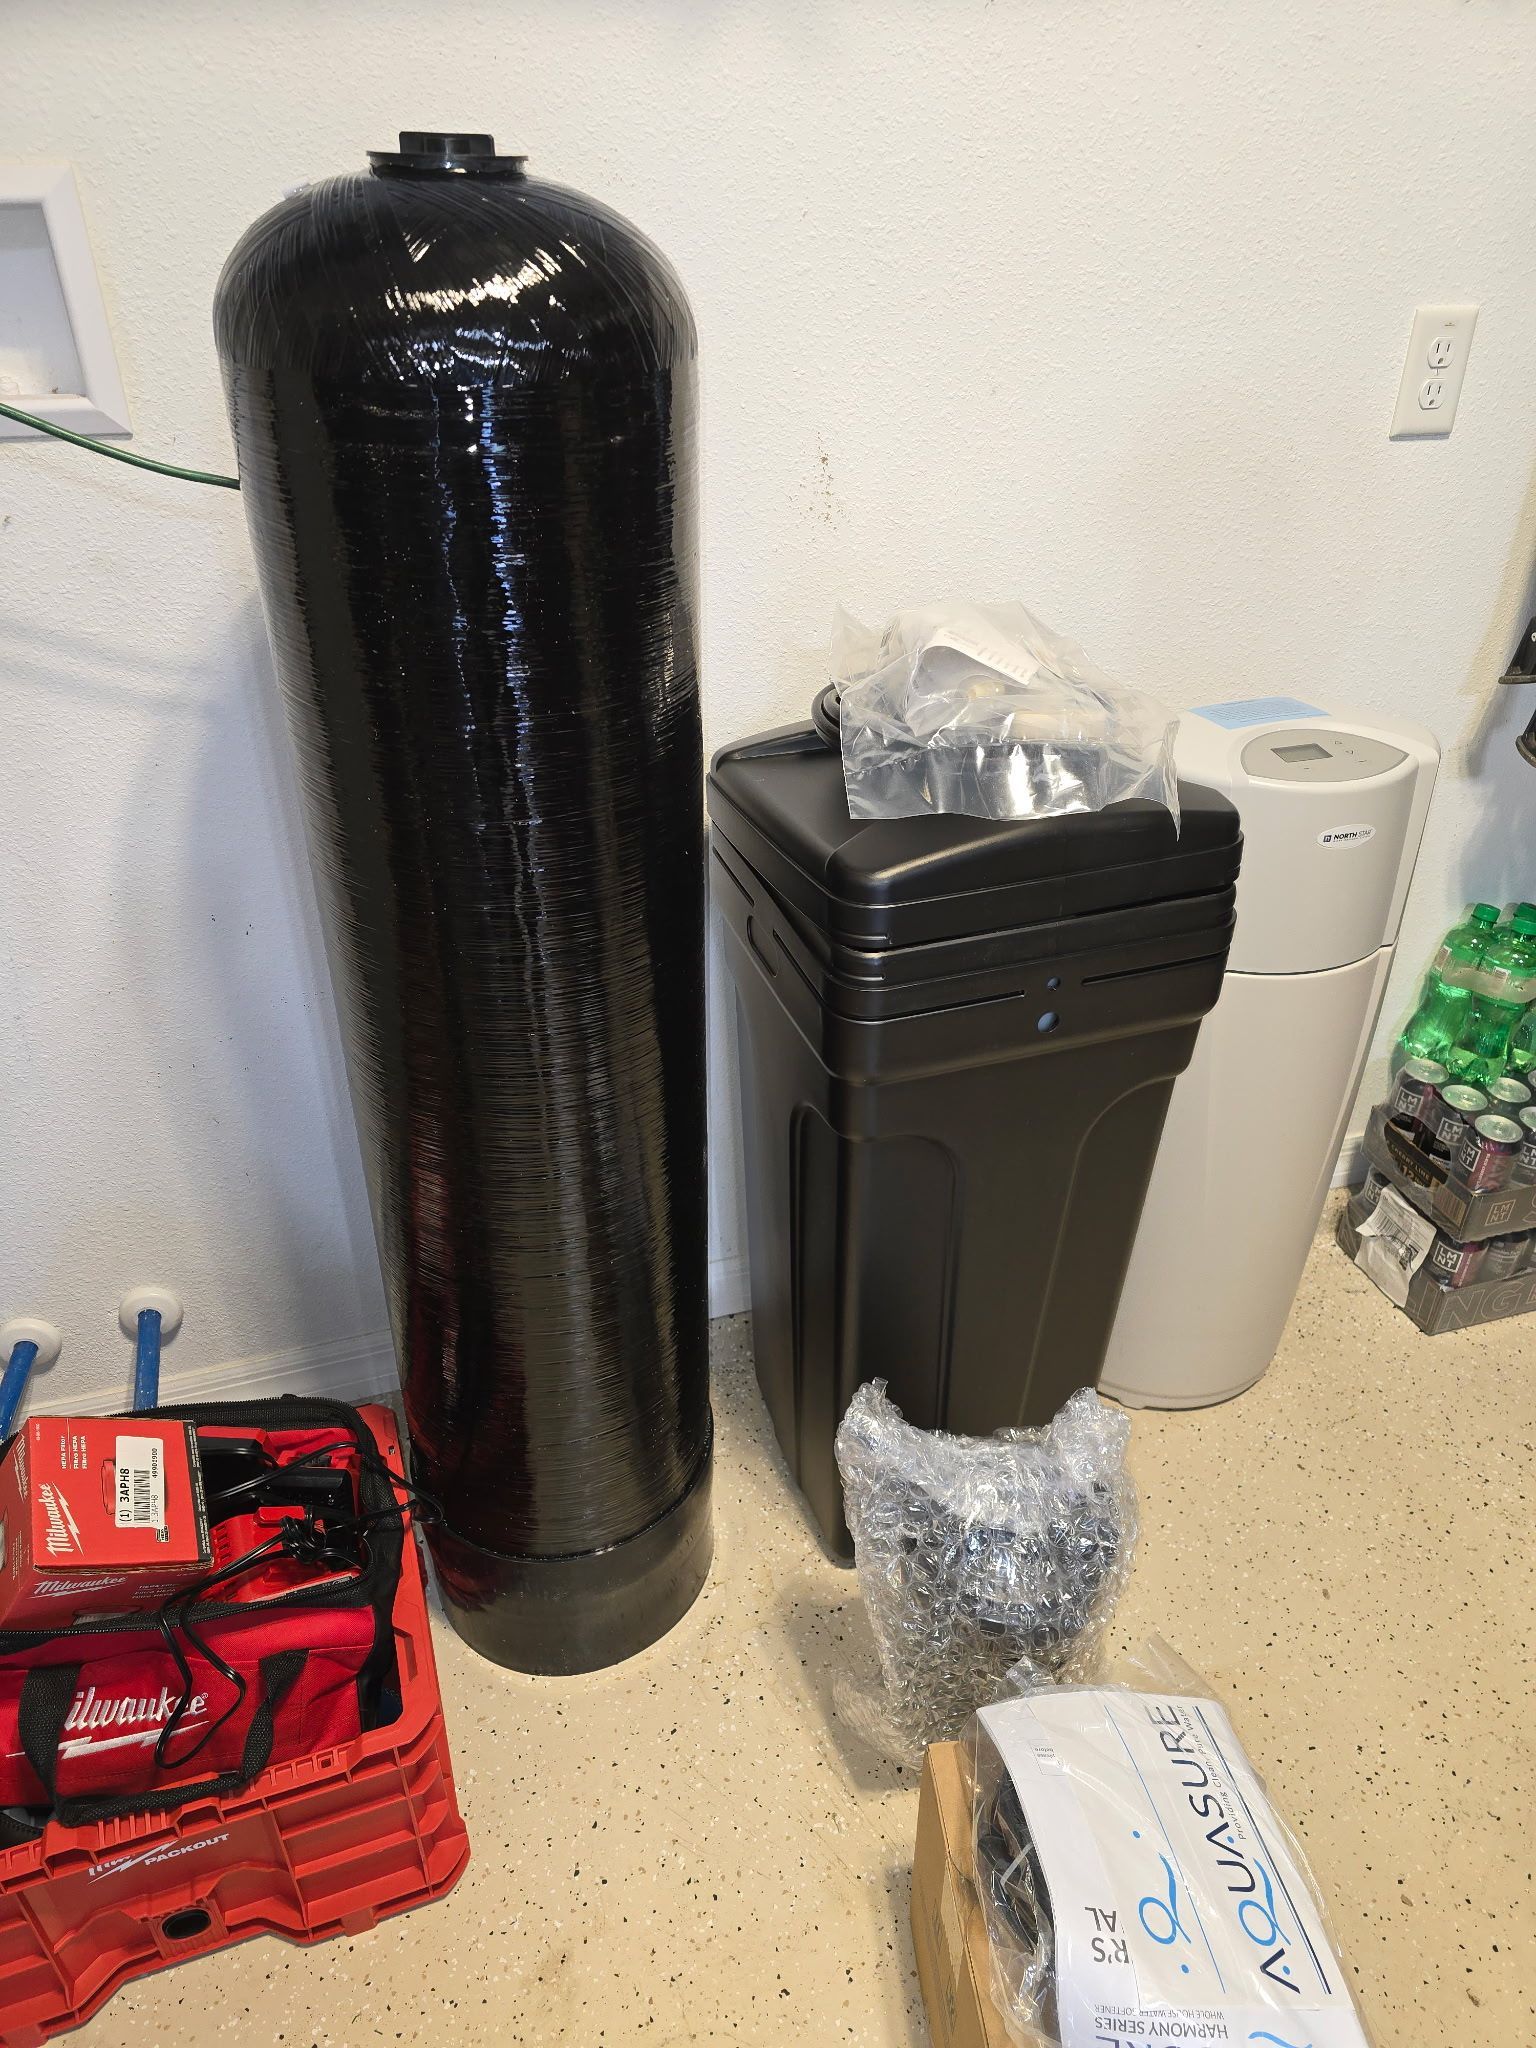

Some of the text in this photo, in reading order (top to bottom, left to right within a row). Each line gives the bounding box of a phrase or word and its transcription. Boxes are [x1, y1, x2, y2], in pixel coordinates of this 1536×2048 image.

[1333, 831, 1358, 840] NORTH
[119, 1468, 133, 1522] (1) 3APH8
[38, 1482, 75, 1558] Milwaukee
[33, 1576, 127, 1595] Milwaukee
[64, 1686, 208, 1732] ilwauke
[1205, 1760, 1222, 1788] Clean
[1219, 1791, 1247, 1840] Providing
[144, 1833, 230, 1866] PACKOUT
[1144, 1704, 1301, 1994] AQUASURE
[1094, 2016, 1229, 2039] HARMONY SERIES
[1196, 2009, 1225, 2020] WHOLE
